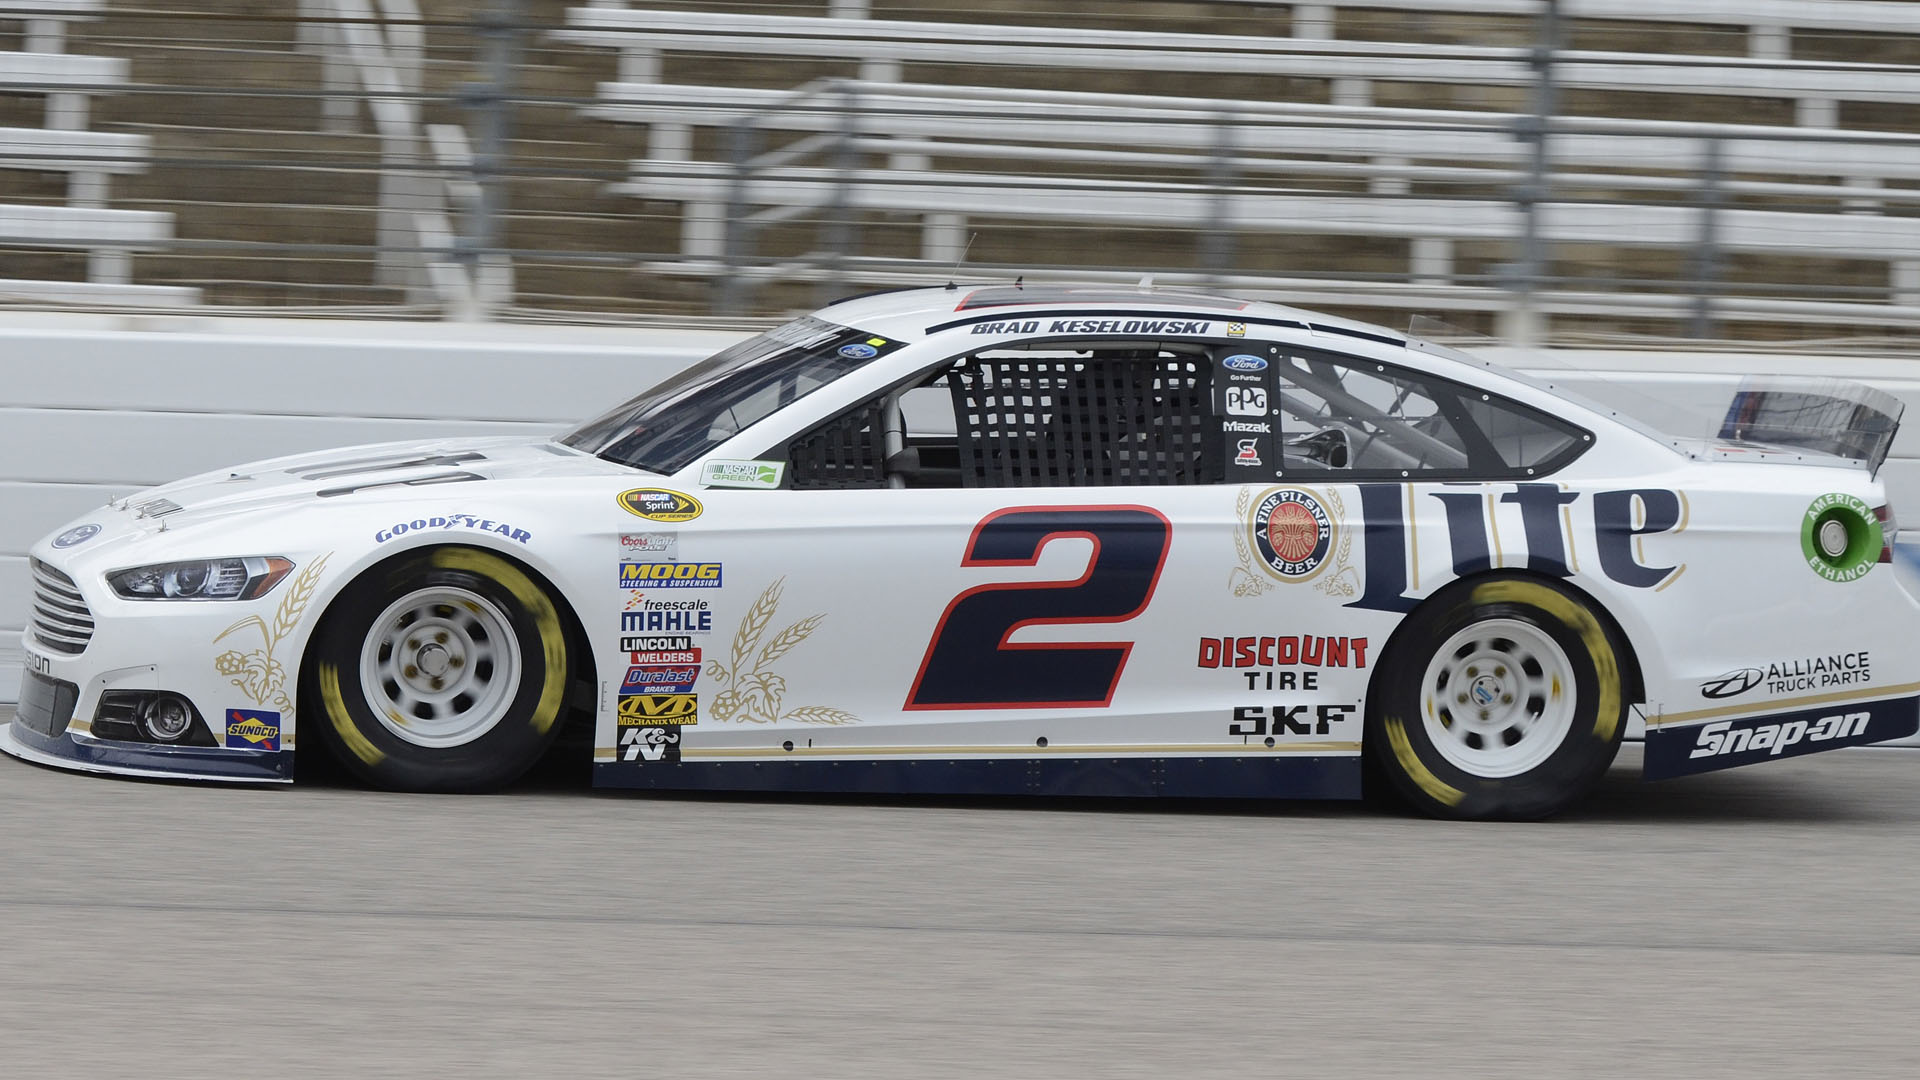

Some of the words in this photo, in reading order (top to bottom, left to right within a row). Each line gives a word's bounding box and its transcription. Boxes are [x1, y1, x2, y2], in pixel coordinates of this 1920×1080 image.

[970, 321, 1040, 335] BRAD
[1049, 320, 1211, 334] KESELOWSKI
[1231, 357, 1259, 369] Ford
[1228, 388, 1265, 410] PPG
[1223, 421, 1271, 433] Mazak
[712, 474, 756, 482] GREEN
[646, 501, 675, 511] Sprint
[1257, 496, 1280, 527] FINE
[1808, 494, 1877, 525] AMERICAN
[1280, 491, 1329, 540] PILSNER
[621, 535, 648, 546] Coors
[1257, 528, 1268, 540] A
[621, 564, 721, 579] MOOG
[1270, 557, 1318, 574] BEER
[1808, 556, 1875, 581] ETHANOL
[644, 599, 708, 610] freescale
[902, 504, 1173, 711] 2
[621, 611, 711, 631] MAHLE
[623, 638, 688, 650] LINCOLN
[1198, 634, 1368, 669] DISCOUNT
[637, 653, 694, 663] WELDERS
[1767, 651, 1870, 680] ALLIANCE
[628, 668, 695, 683] Duralast
[1244, 671, 1318, 690] TIRE
[1767, 674, 1816, 694] TRUCK
[1821, 669, 1871, 687] PARTS
[618, 716, 668, 725] MECHANIX
[669, 714, 698, 725] WEAR
[1229, 704, 1356, 735] SKF
[230, 724, 276, 737] SUNOCO
[1689, 711, 1871, 759] Snap-on
